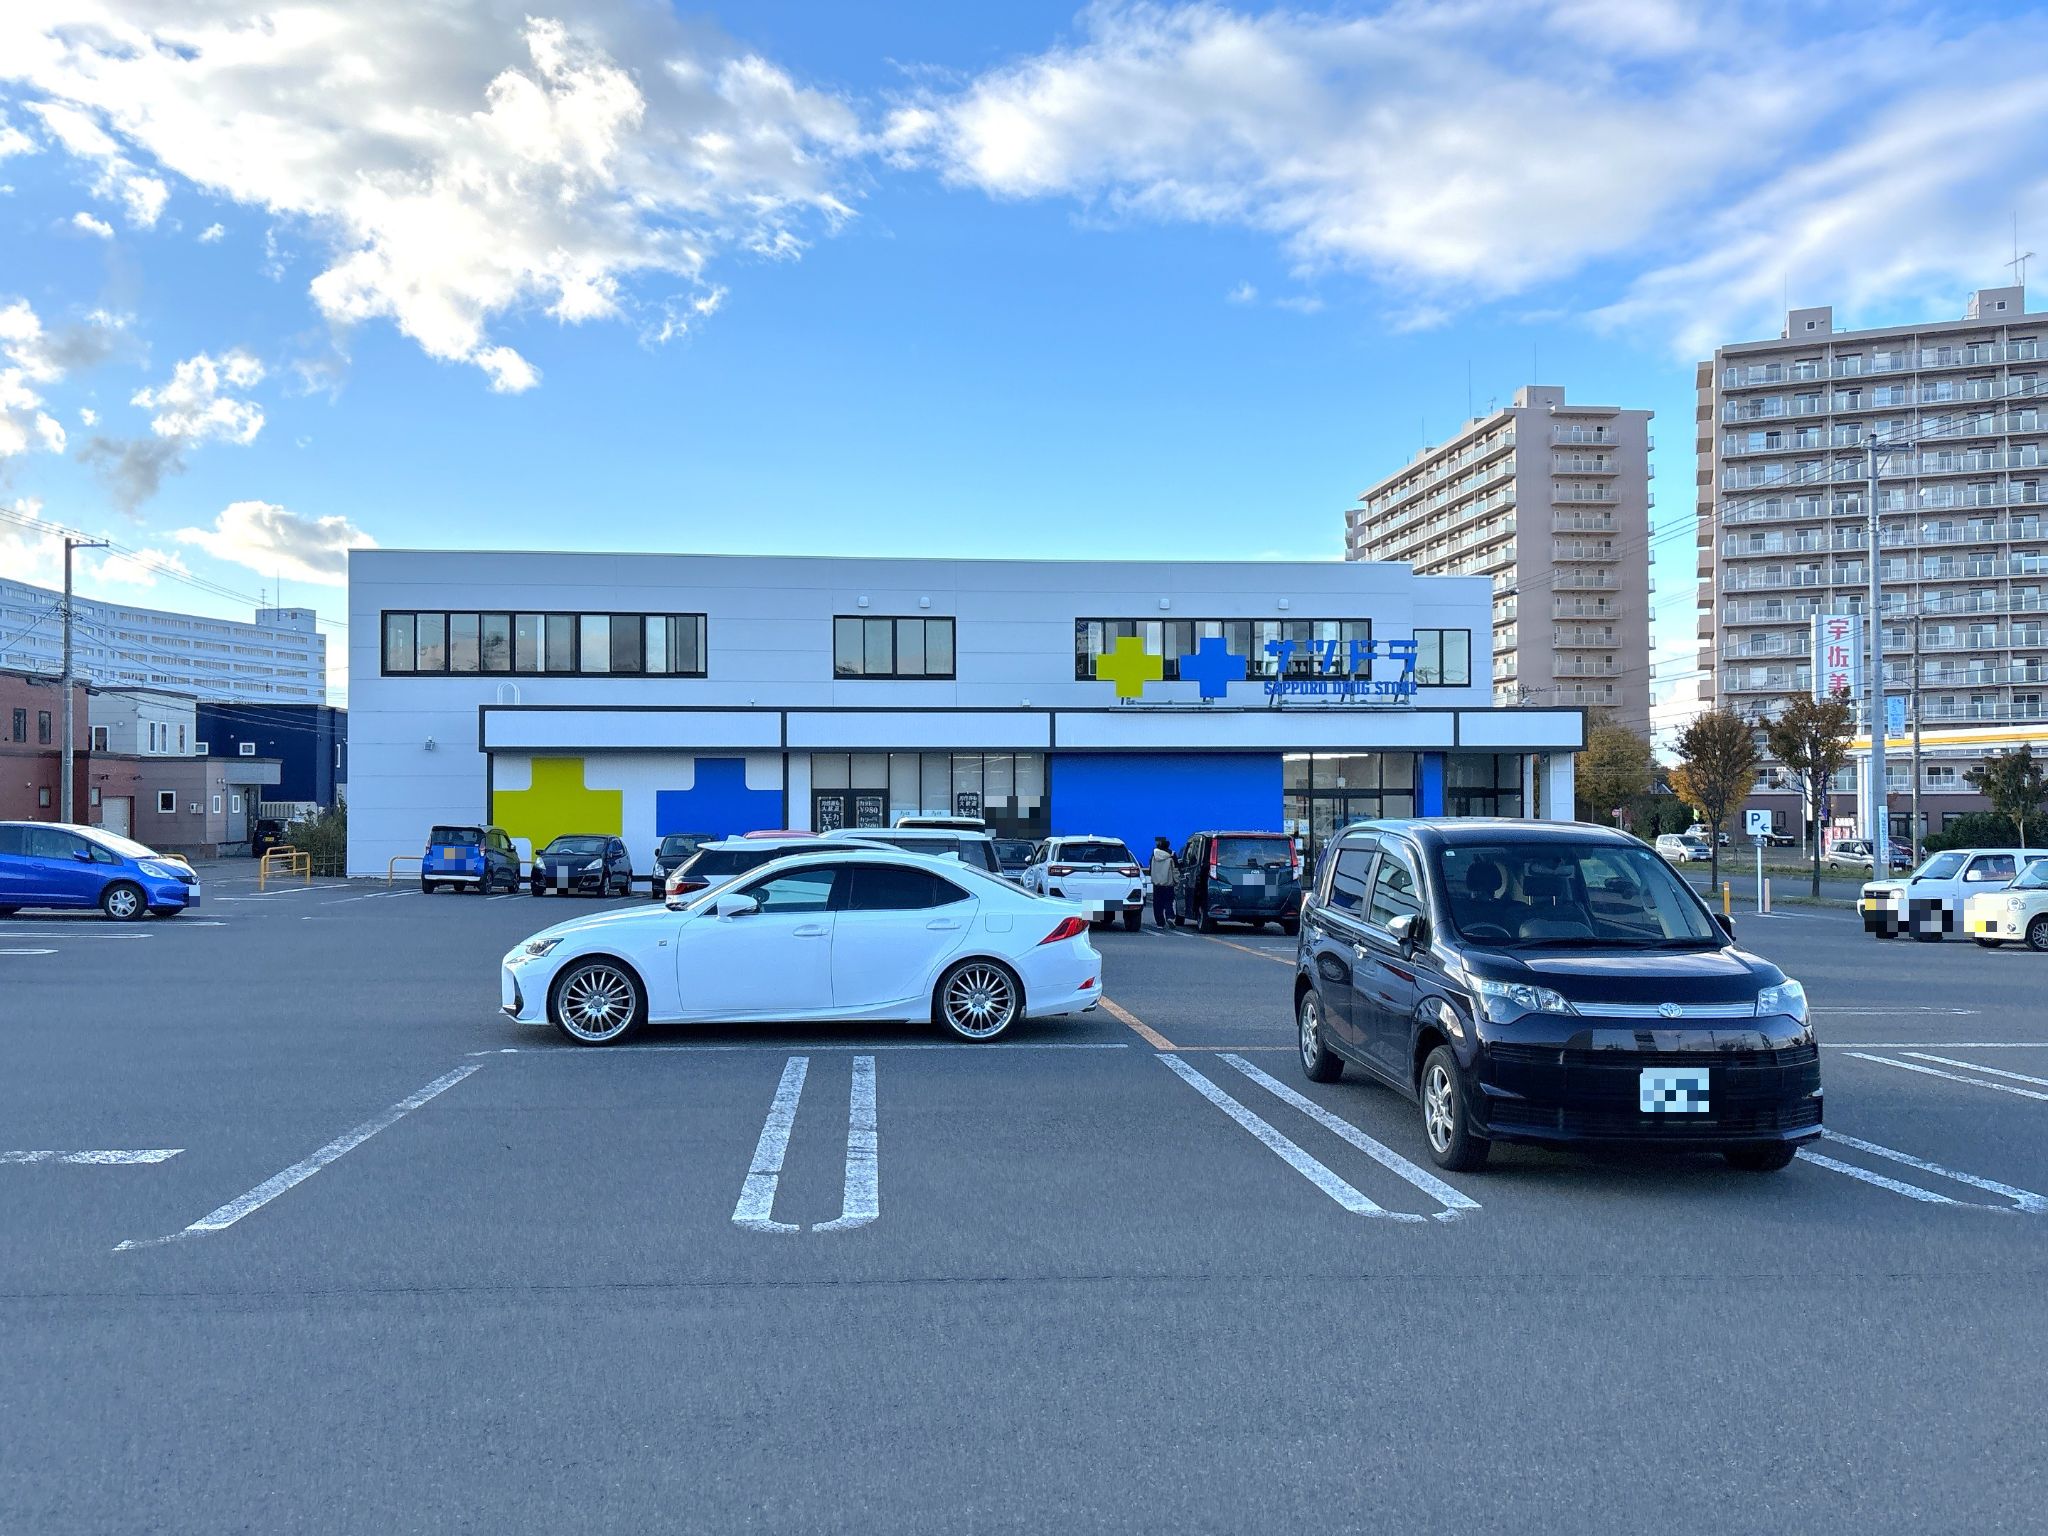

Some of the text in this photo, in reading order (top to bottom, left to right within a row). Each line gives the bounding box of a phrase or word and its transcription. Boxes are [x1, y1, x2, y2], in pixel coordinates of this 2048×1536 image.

[1264, 639, 1418, 673] サツドラ
[1264, 681, 1418, 695] SAPPORO DRUG STORE
[1751, 813, 1761, 826] P
